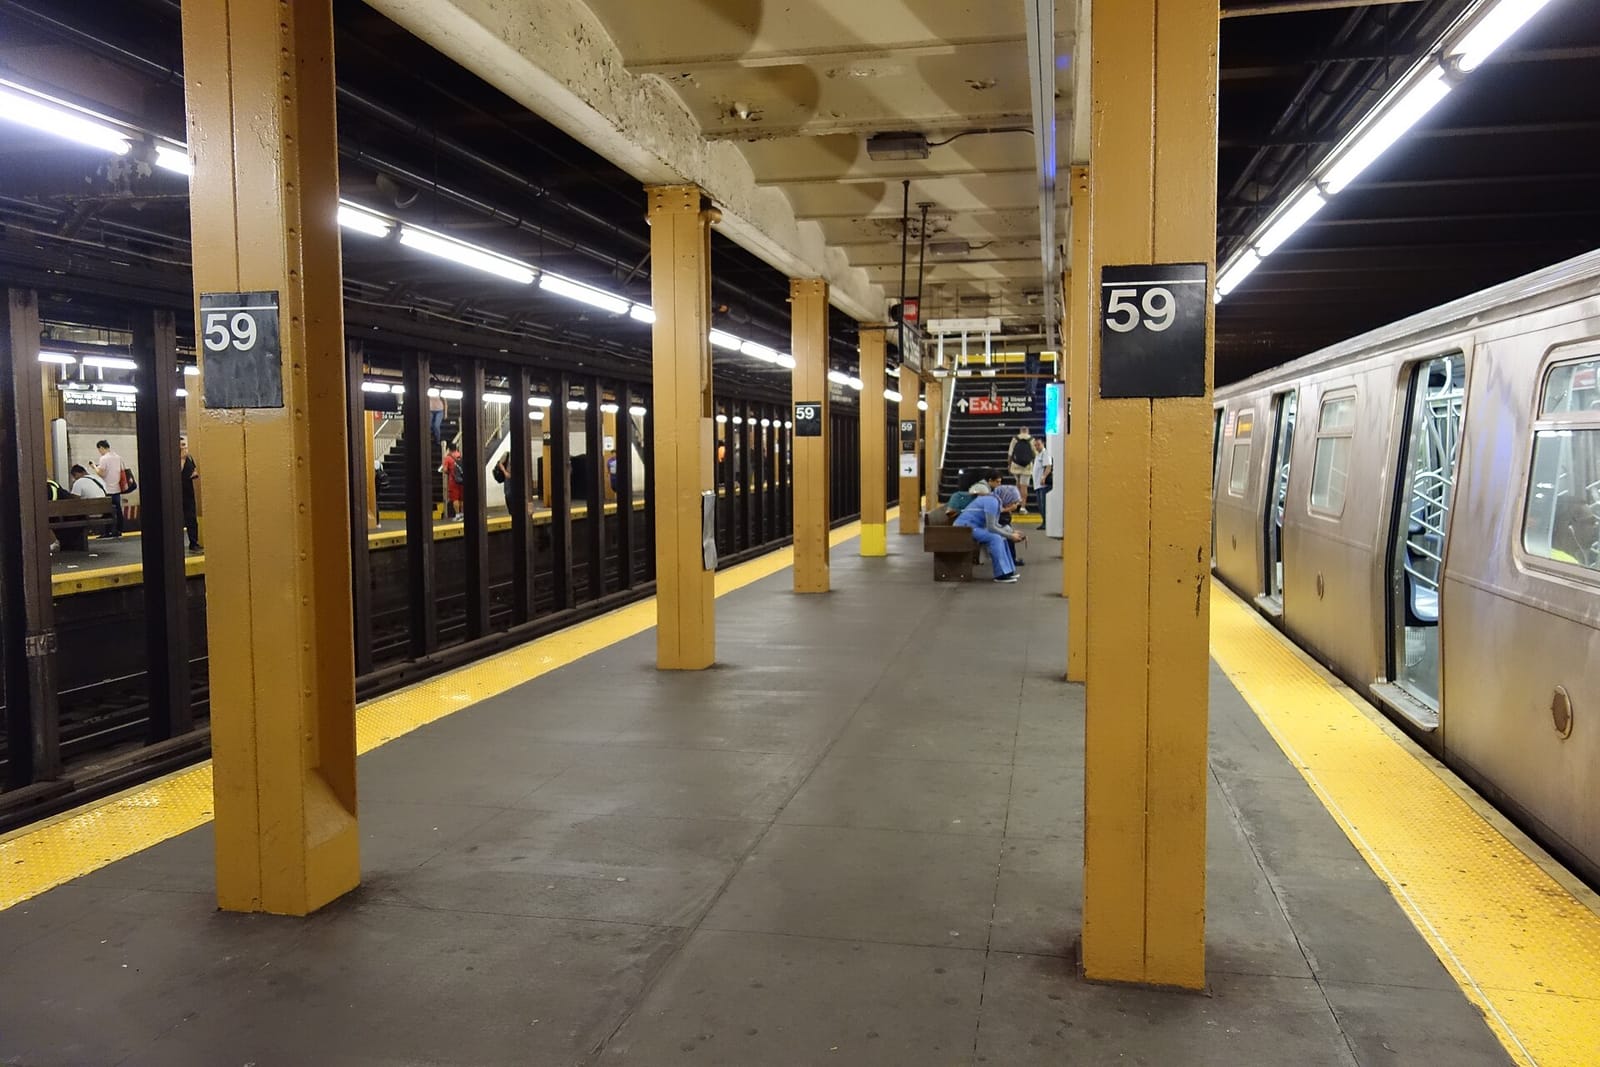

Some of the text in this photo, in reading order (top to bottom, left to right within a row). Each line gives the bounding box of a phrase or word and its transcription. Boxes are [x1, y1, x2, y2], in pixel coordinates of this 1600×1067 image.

[1106, 287, 1175, 332] 59
[204, 312, 257, 351] 59
[795, 407, 815, 420] 59
[901, 423, 913, 432] 59
